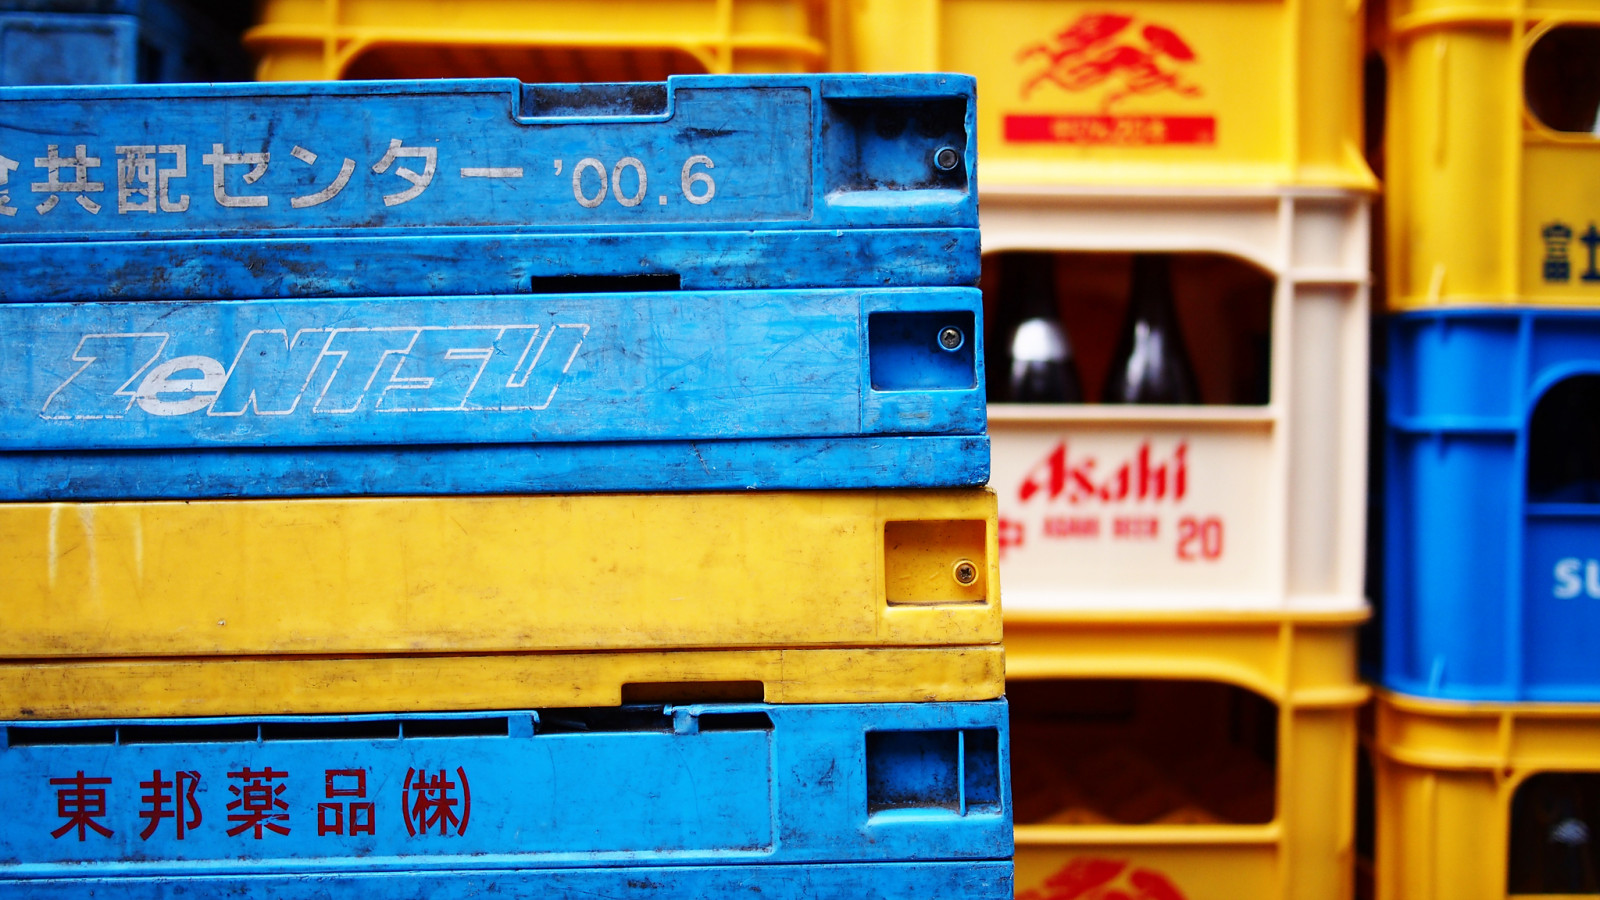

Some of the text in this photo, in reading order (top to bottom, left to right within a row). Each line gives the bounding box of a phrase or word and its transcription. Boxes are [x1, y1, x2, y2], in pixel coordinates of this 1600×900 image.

[0, 138, 524, 216] 共配センター
[1019, 438, 1189, 504] Asahi
[1176, 515, 1224, 562] 20
